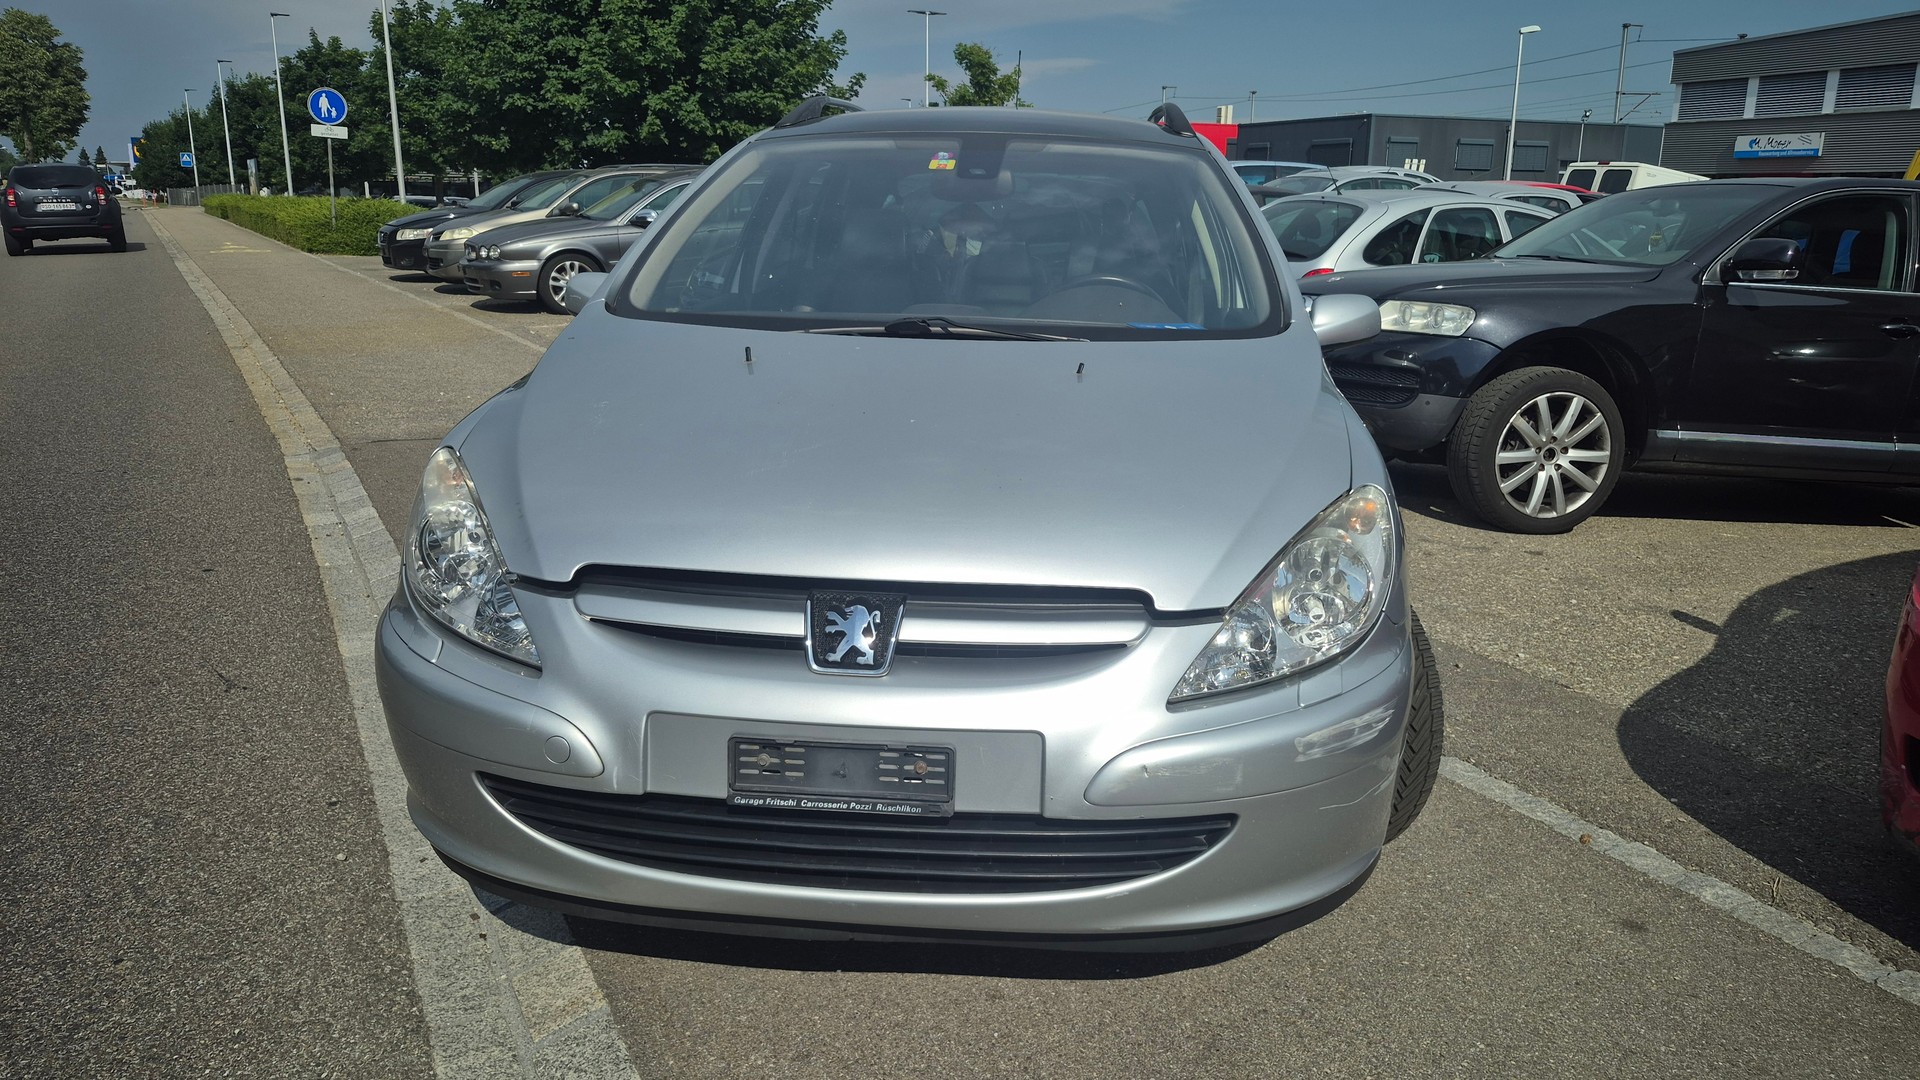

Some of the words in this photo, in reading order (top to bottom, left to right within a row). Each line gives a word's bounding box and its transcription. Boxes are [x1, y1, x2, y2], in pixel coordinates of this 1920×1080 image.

[734, 796, 764, 806] Garage
[765, 798, 797, 807] Fritschi
[801, 800, 848, 809] Carrosserie
[850, 802, 872, 811] Pozzi
